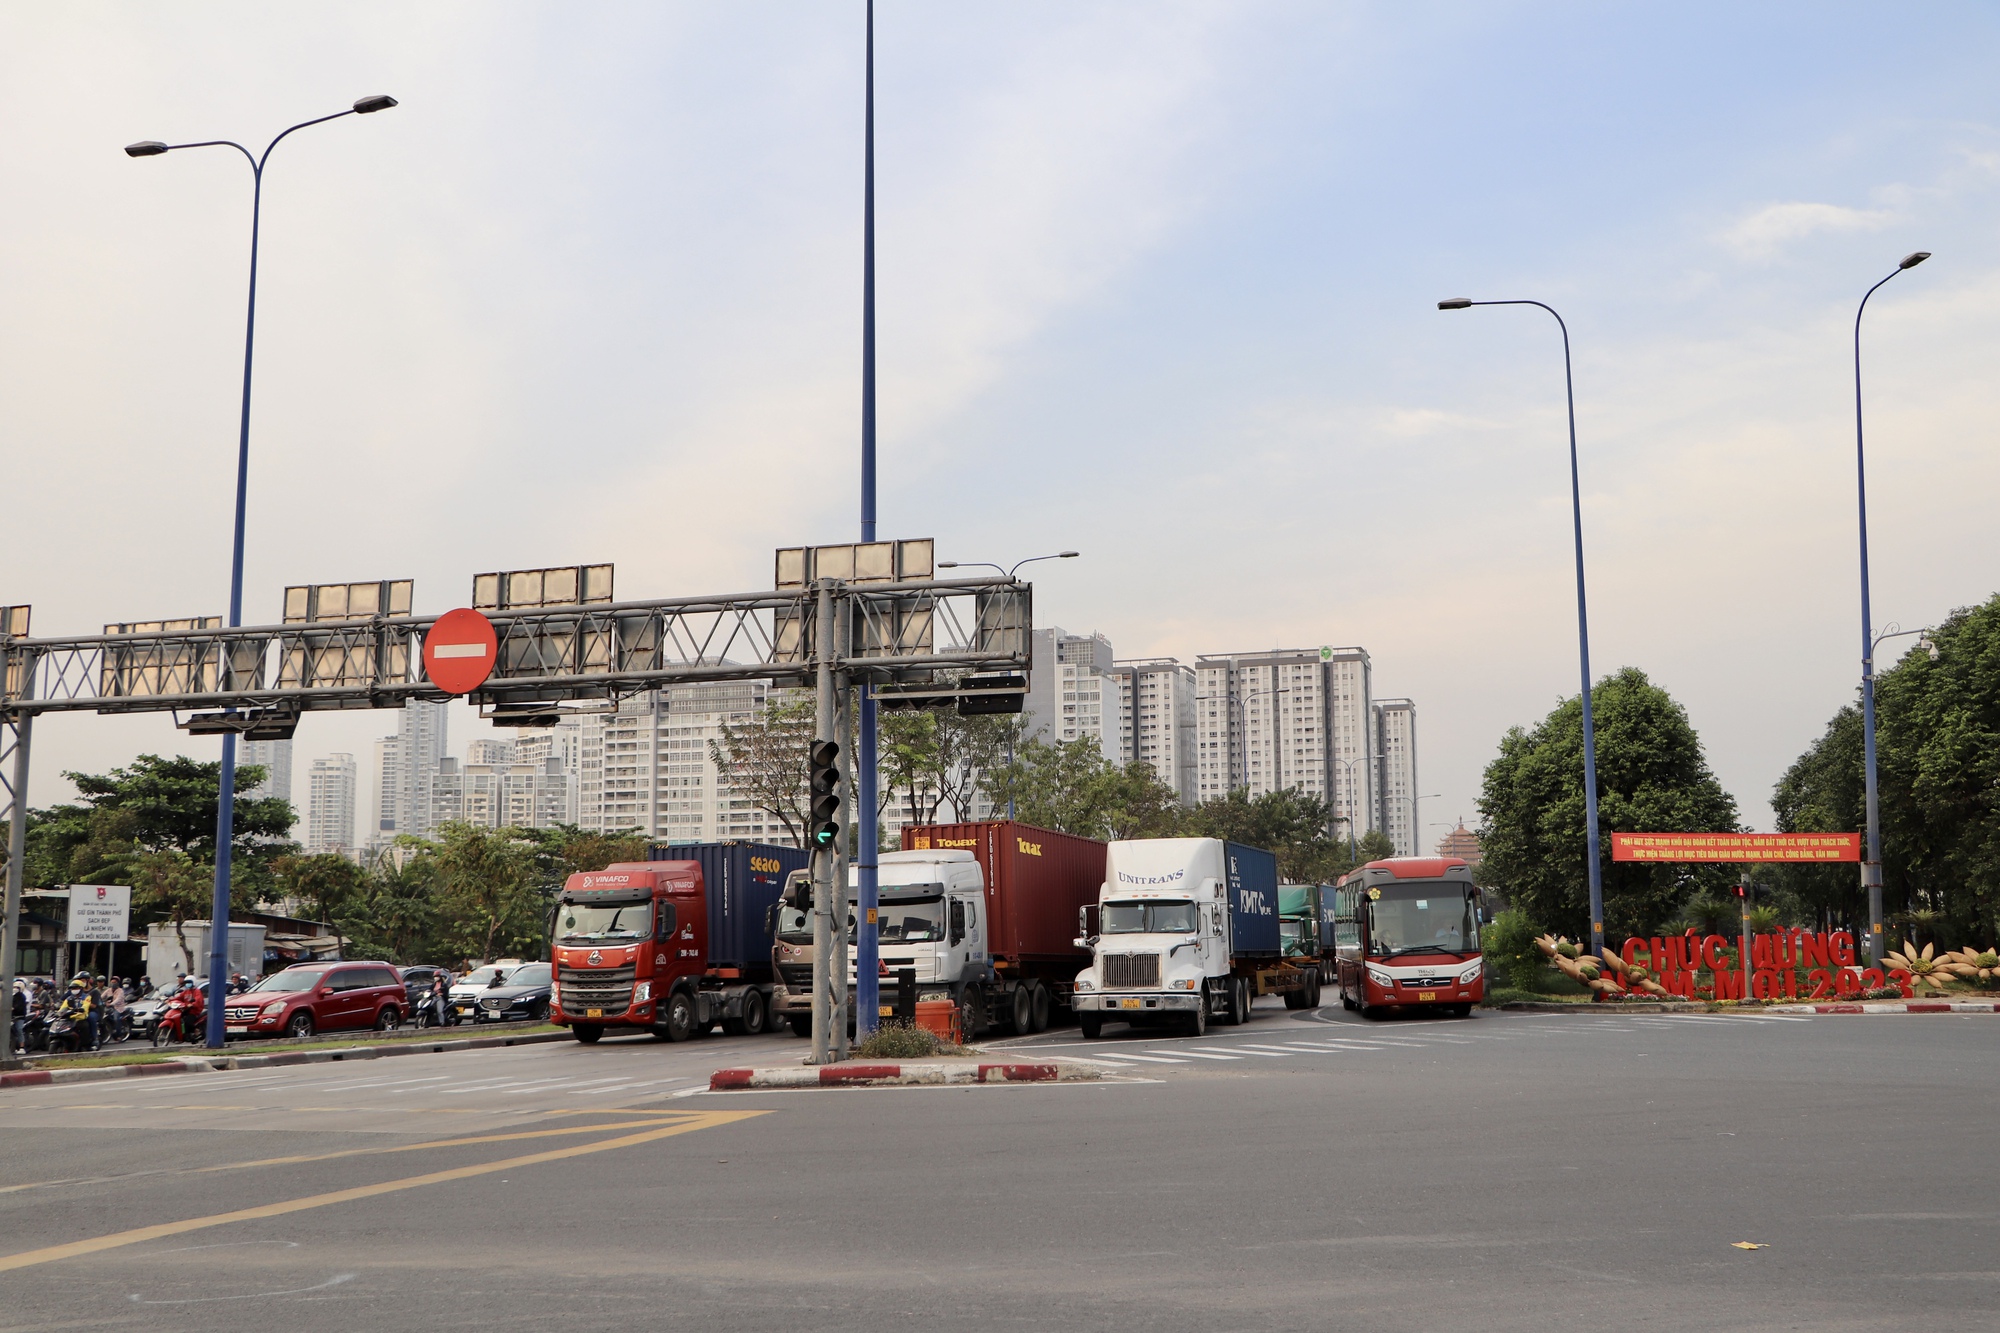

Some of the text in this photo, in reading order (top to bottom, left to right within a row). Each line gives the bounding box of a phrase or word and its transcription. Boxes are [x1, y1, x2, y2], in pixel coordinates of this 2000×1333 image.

[1655, 838, 1670, 847] MẠNH
[1707, 836, 1716, 846] KẾT
[1717, 837, 1730, 846] TOÀN
[1810, 838, 1820, 846] QUA
[1820, 836, 1837, 846] THÁCH
[1826, 850, 1840, 858] MINH
[750, 856, 780, 873] seaco
[1118, 869, 1184, 884] UNITRANS
[1240, 889, 1264, 914] KMTC
[1622, 924, 1855, 972] CHÚC MỪNG
[1600, 960, 1914, 1001] NM MỚI 2023
